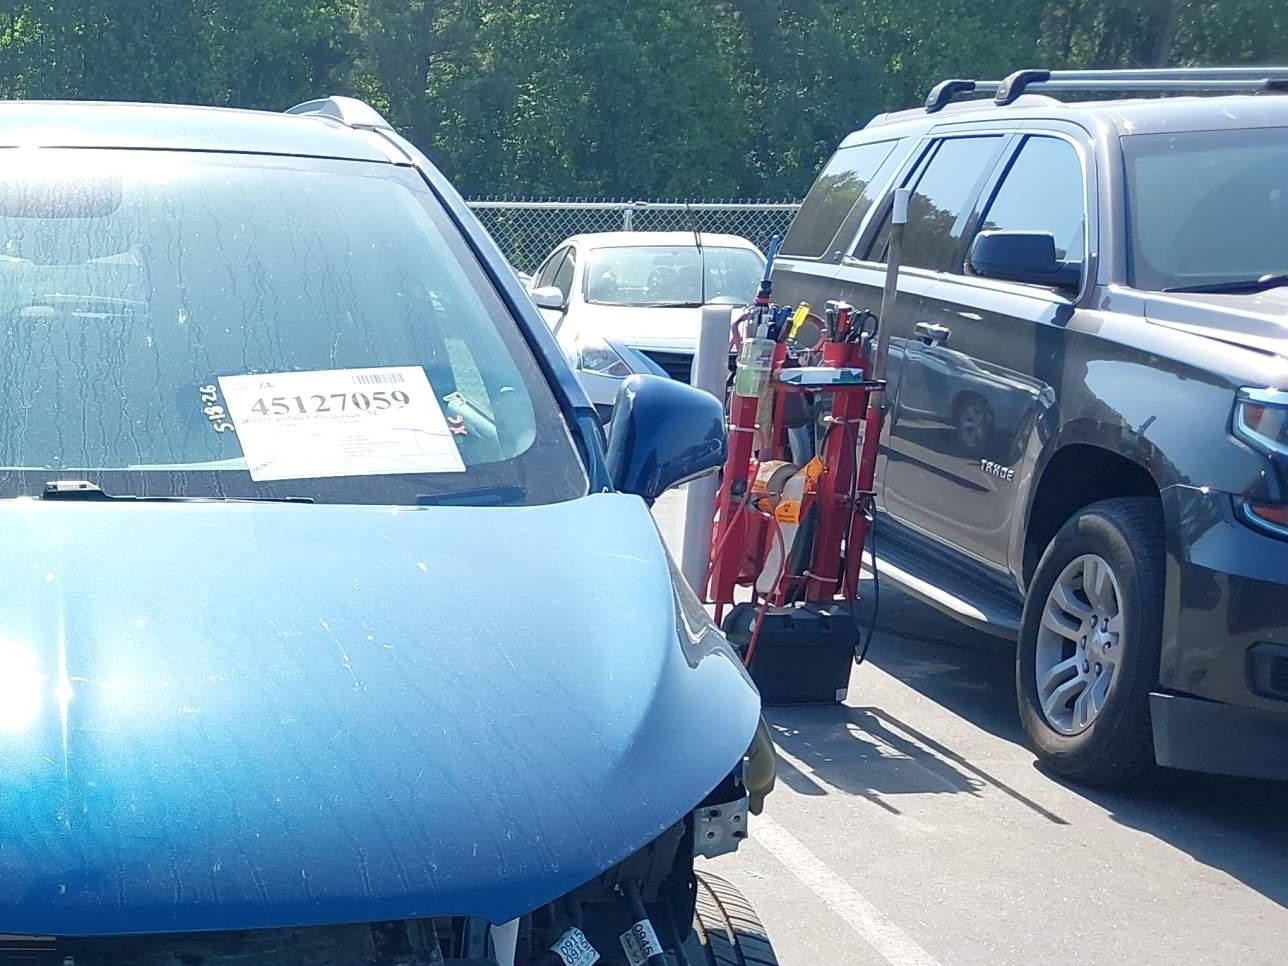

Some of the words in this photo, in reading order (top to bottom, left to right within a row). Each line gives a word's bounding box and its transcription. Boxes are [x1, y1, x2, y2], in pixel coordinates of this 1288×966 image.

[251, 389, 411, 416] 45127059
[980, 458, 1016, 482] TAHOE
[560, 929, 583, 956] 0915
